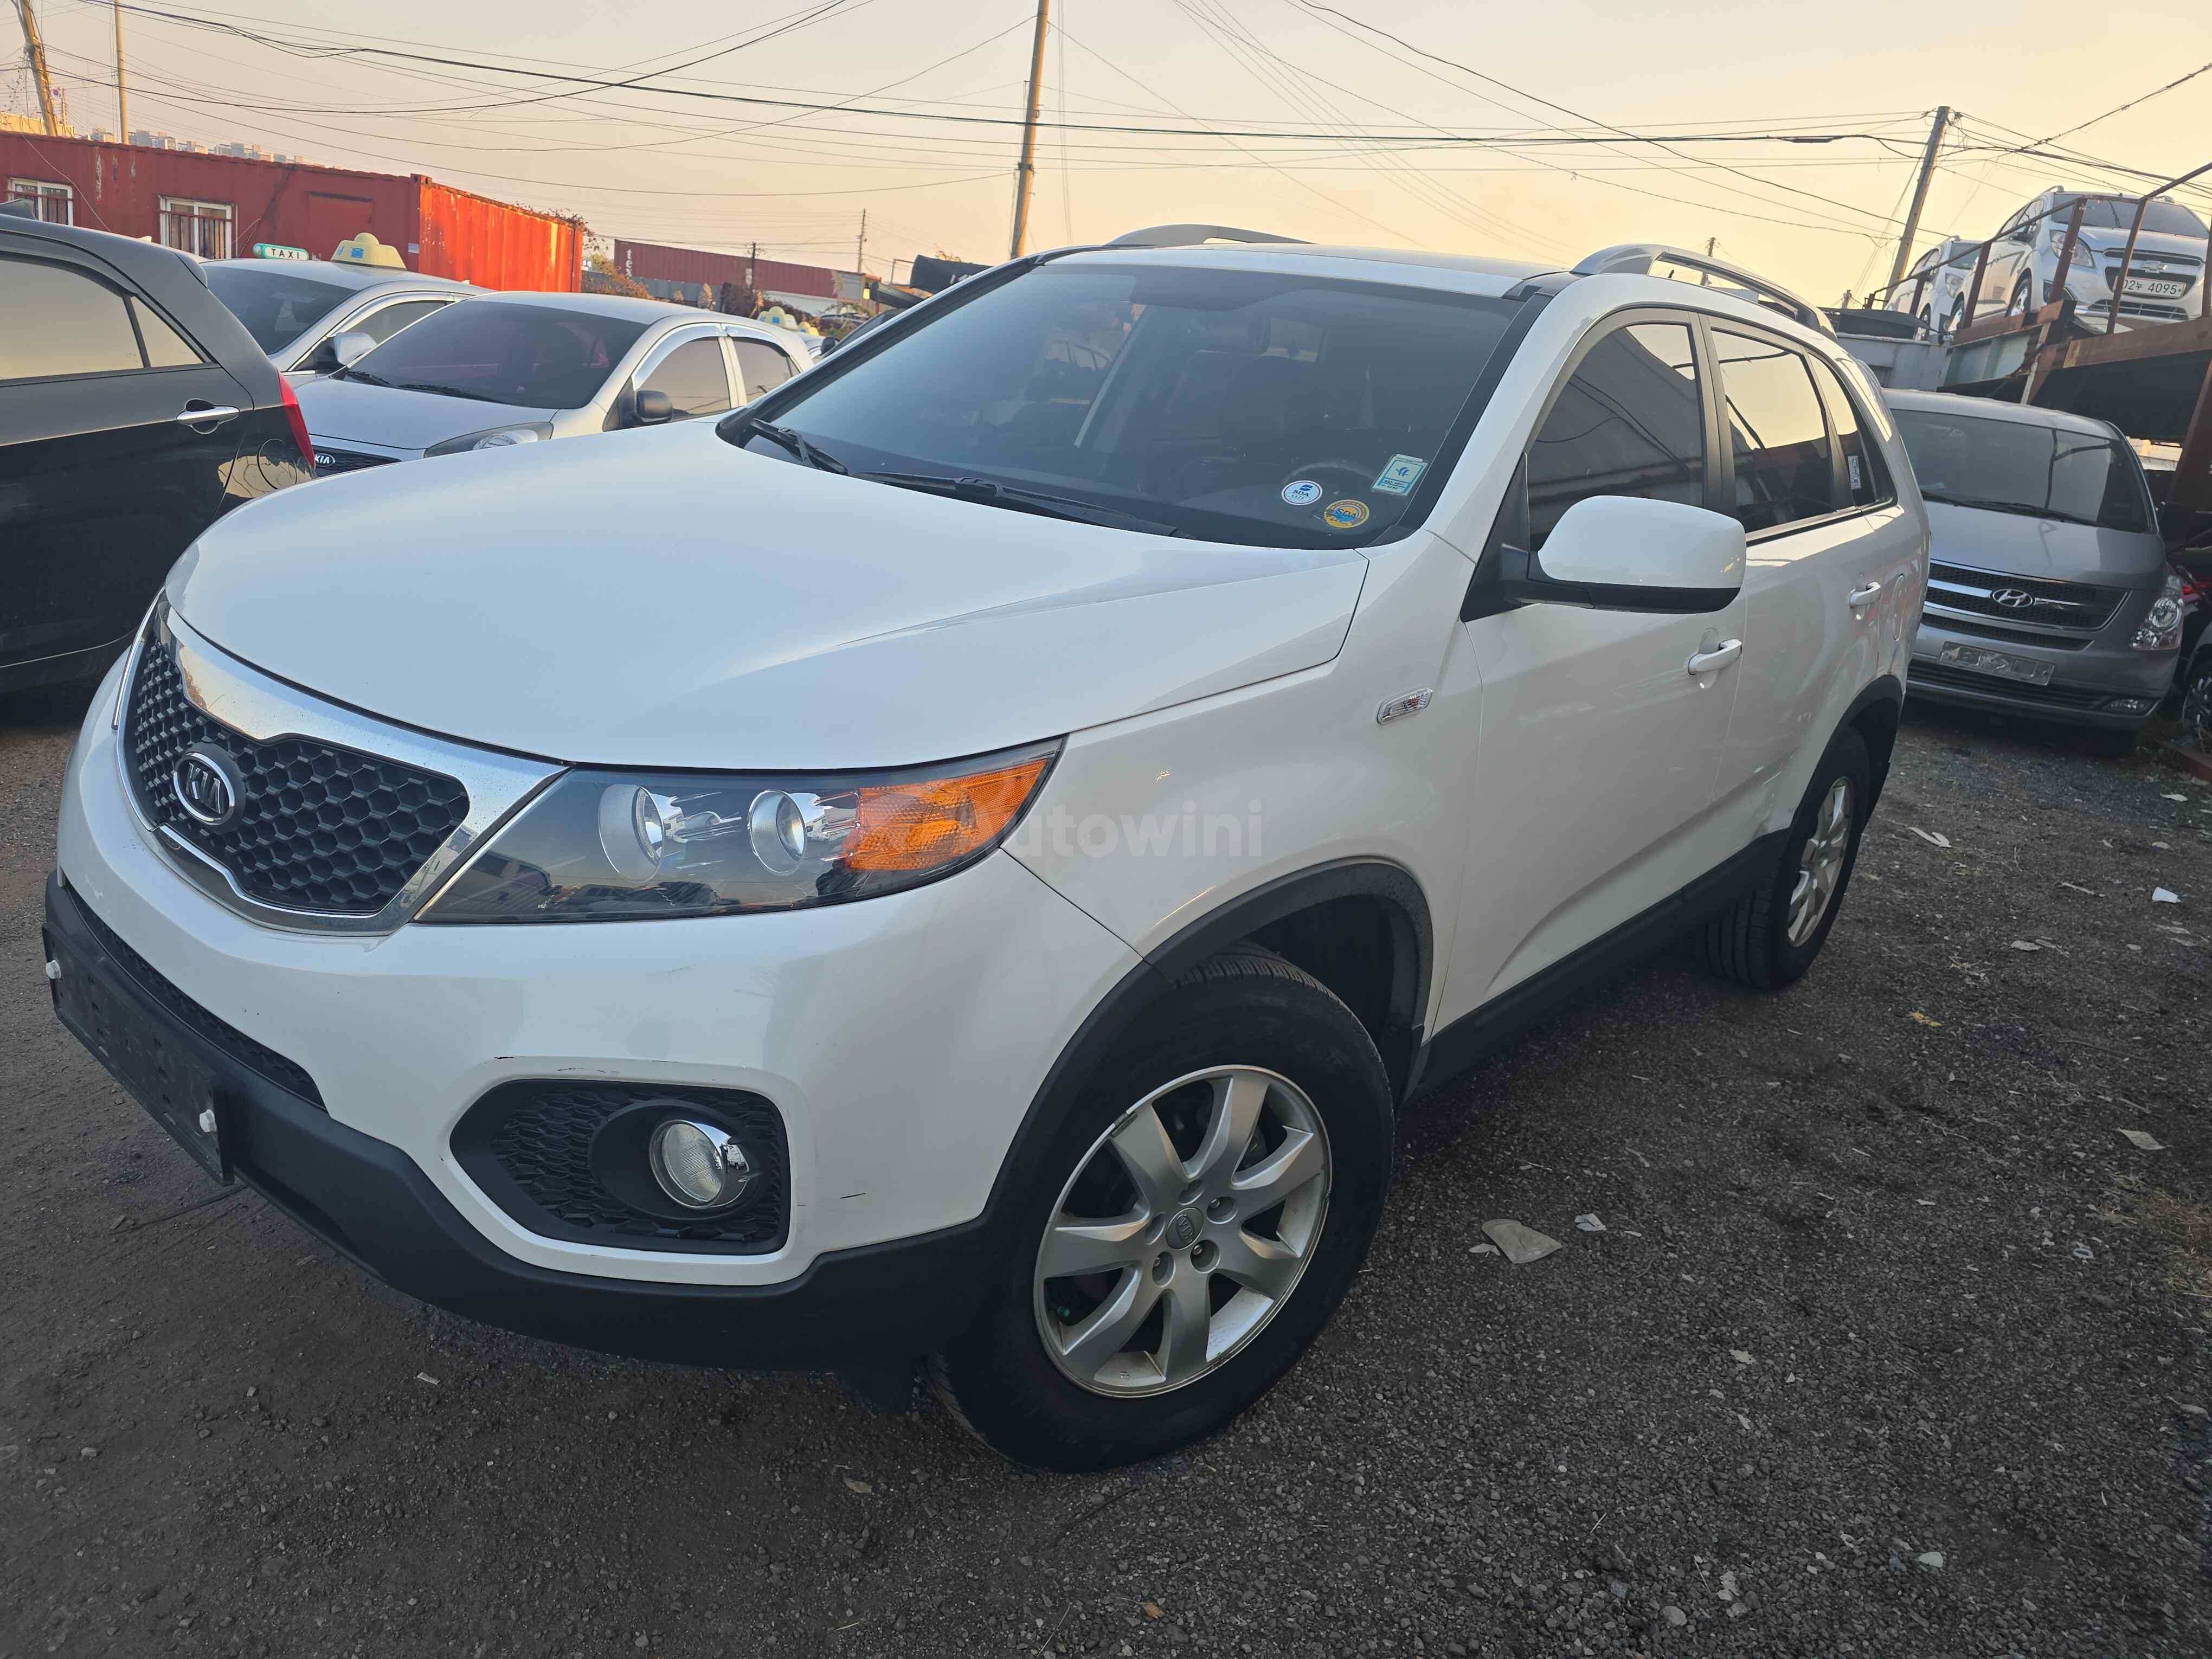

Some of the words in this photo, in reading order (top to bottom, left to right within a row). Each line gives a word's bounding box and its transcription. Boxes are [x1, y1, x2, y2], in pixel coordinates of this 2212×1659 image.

[271, 248, 299, 259] TAXI
[2147, 282, 2177, 294] 4095
[314, 455, 330, 464] KIA
[1335, 508, 1356, 518] SDA
[185, 762, 222, 814] KIA
